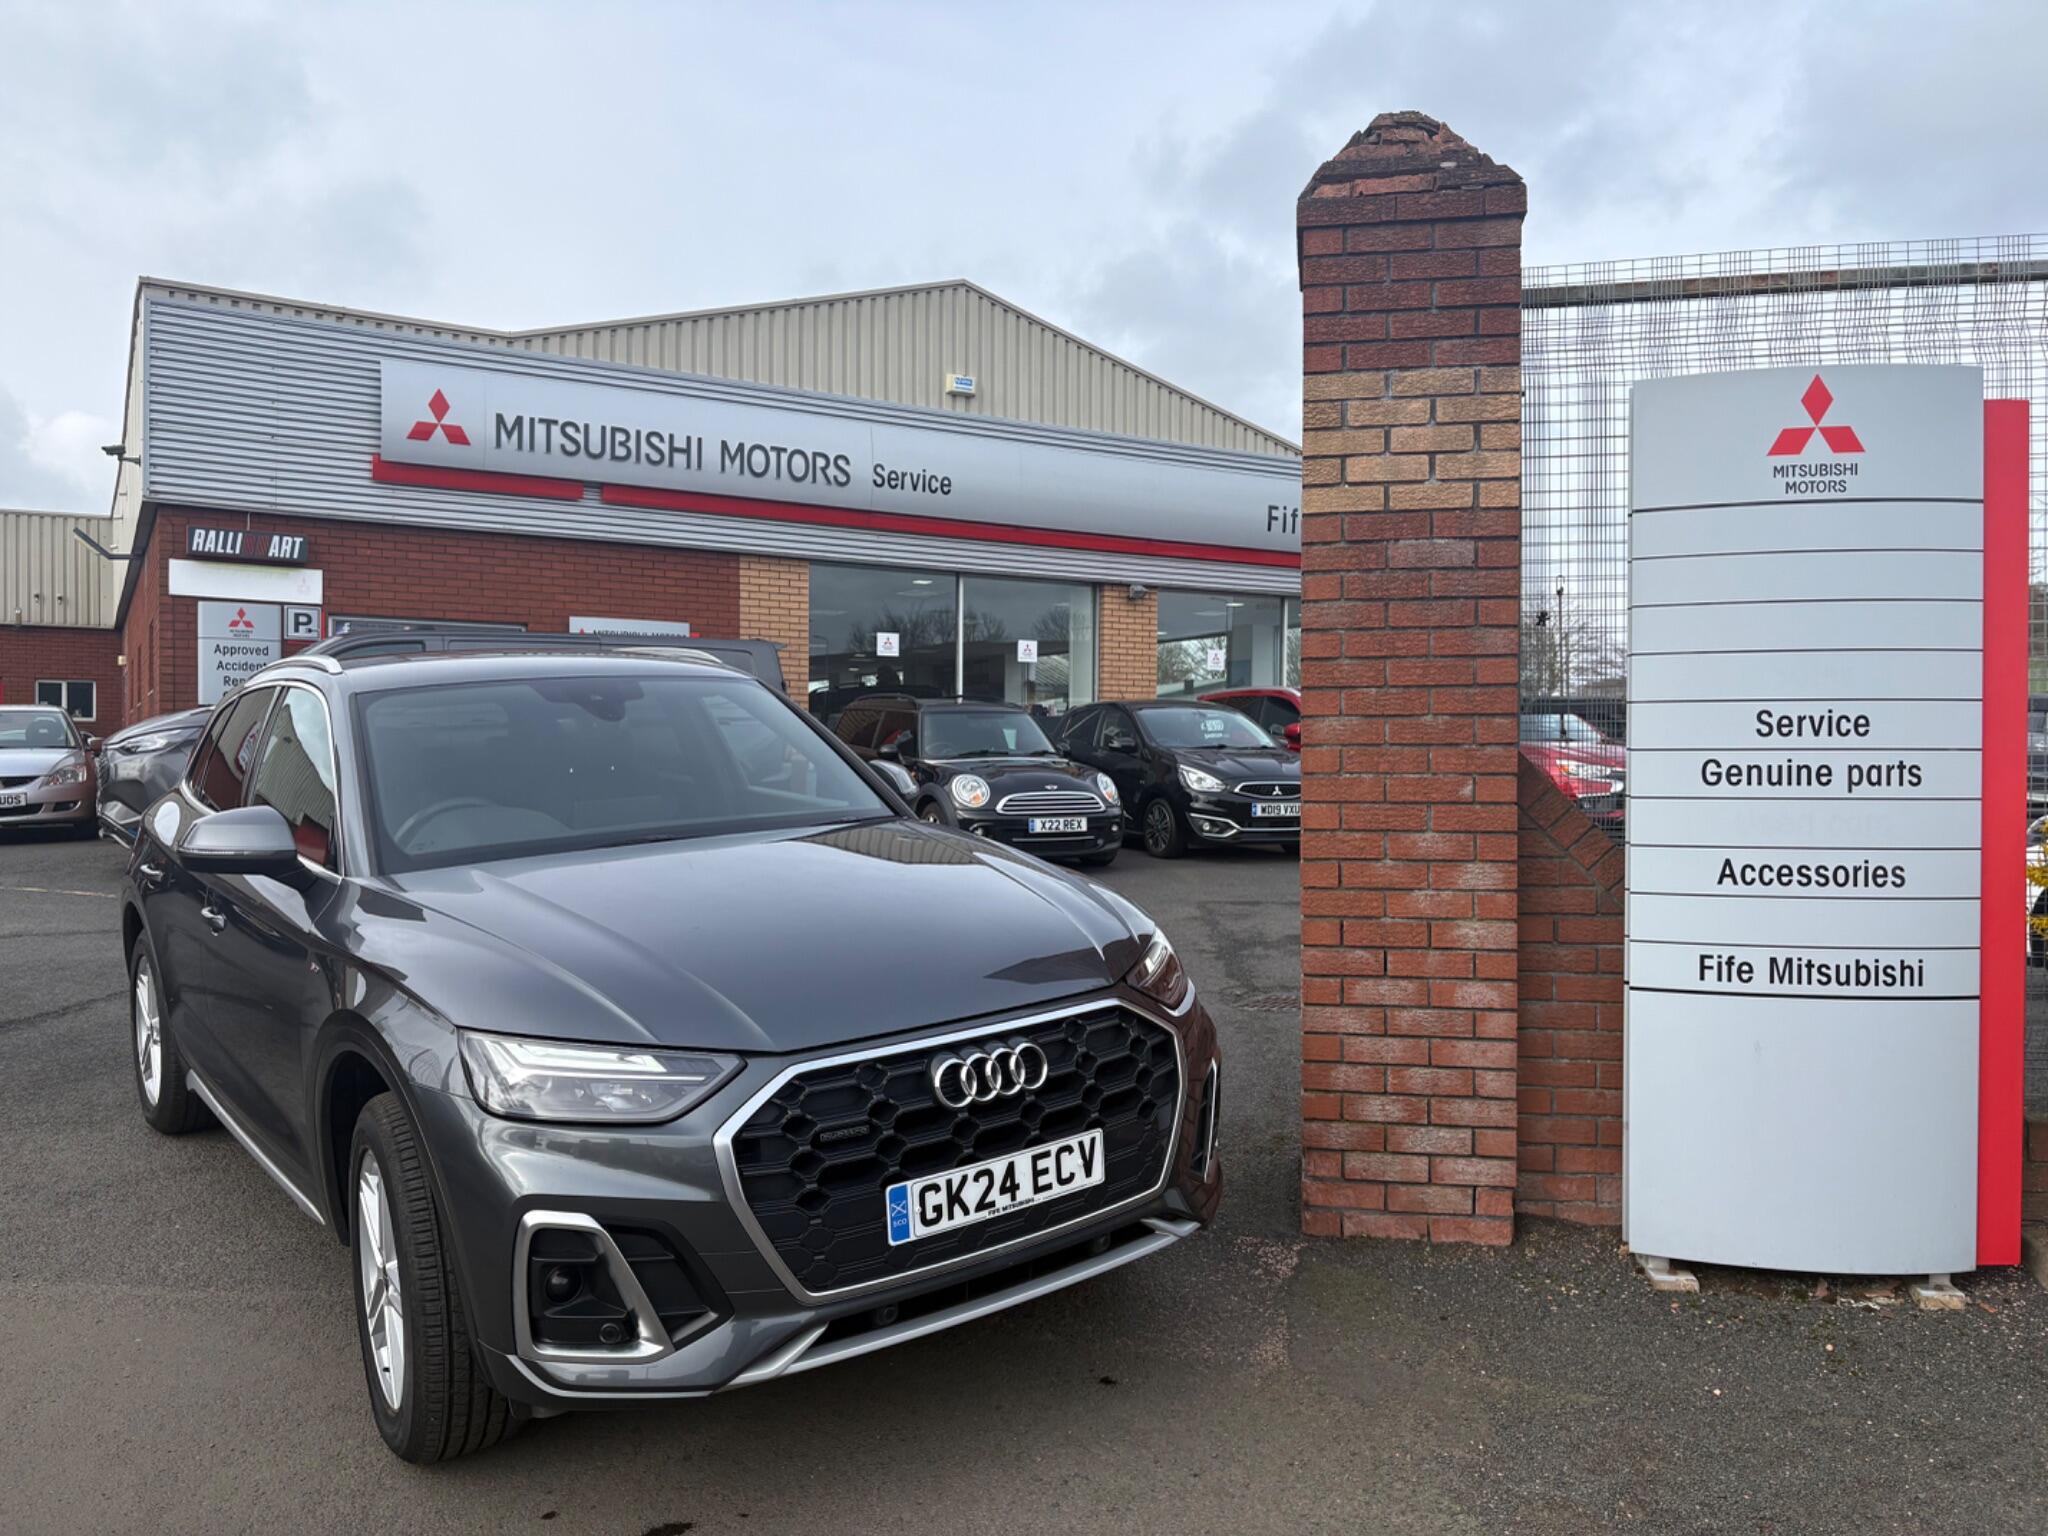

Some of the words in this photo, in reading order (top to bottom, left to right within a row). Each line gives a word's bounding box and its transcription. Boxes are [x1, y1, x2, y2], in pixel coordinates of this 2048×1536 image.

[495, 412, 703, 471] MITSUBISHI
[720, 439, 852, 488] MOTORS
[872, 463, 952, 496] Service
[1773, 463, 1858, 478] MITSUBISHI
[1785, 480, 1847, 494] MOTORS
[1267, 505, 1298, 534] Fif
[294, 612, 312, 633] P
[214, 644, 269, 657] Approved
[1755, 709, 1871, 738] Service
[1701, 758, 1833, 787] Genuine
[1847, 760, 1923, 793] parts
[1041, 820, 1060, 831] X22
[1064, 819, 1082, 830] REX
[1717, 858, 1906, 888] Accessories
[1699, 954, 1754, 984] Fife
[1769, 957, 1924, 987] Mitsubishi
[919, 1161, 1020, 1228] GK24
[1031, 1136, 1096, 1195] ECV
